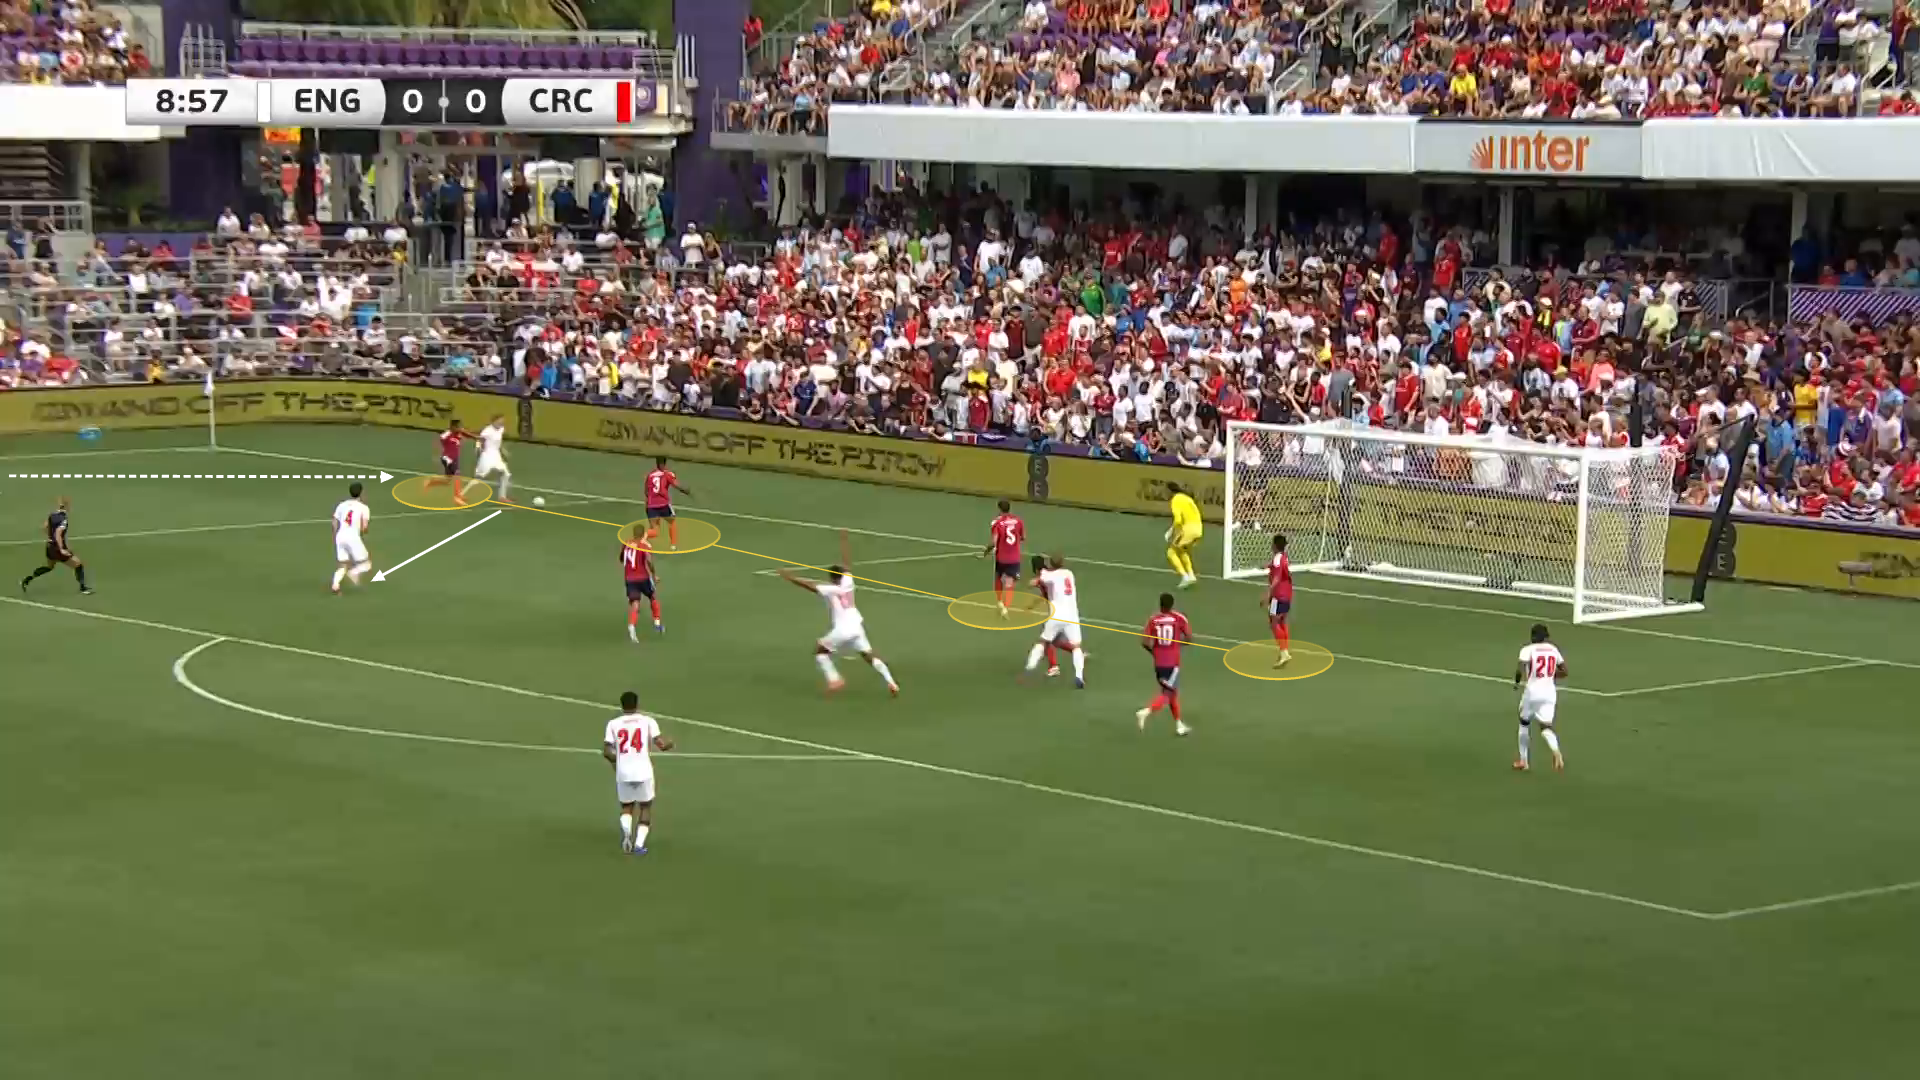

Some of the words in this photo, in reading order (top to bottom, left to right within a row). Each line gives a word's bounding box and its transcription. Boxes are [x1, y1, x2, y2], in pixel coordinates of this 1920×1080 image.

[1500, 130, 1590, 172] inter
[703, 430, 767, 455] OFF
[772, 438, 837, 466] THE
[343, 509, 353, 527] 4
[1155, 624, 1174, 646] 10
[1535, 655, 1557, 679] 20
[616, 727, 644, 754] 24
